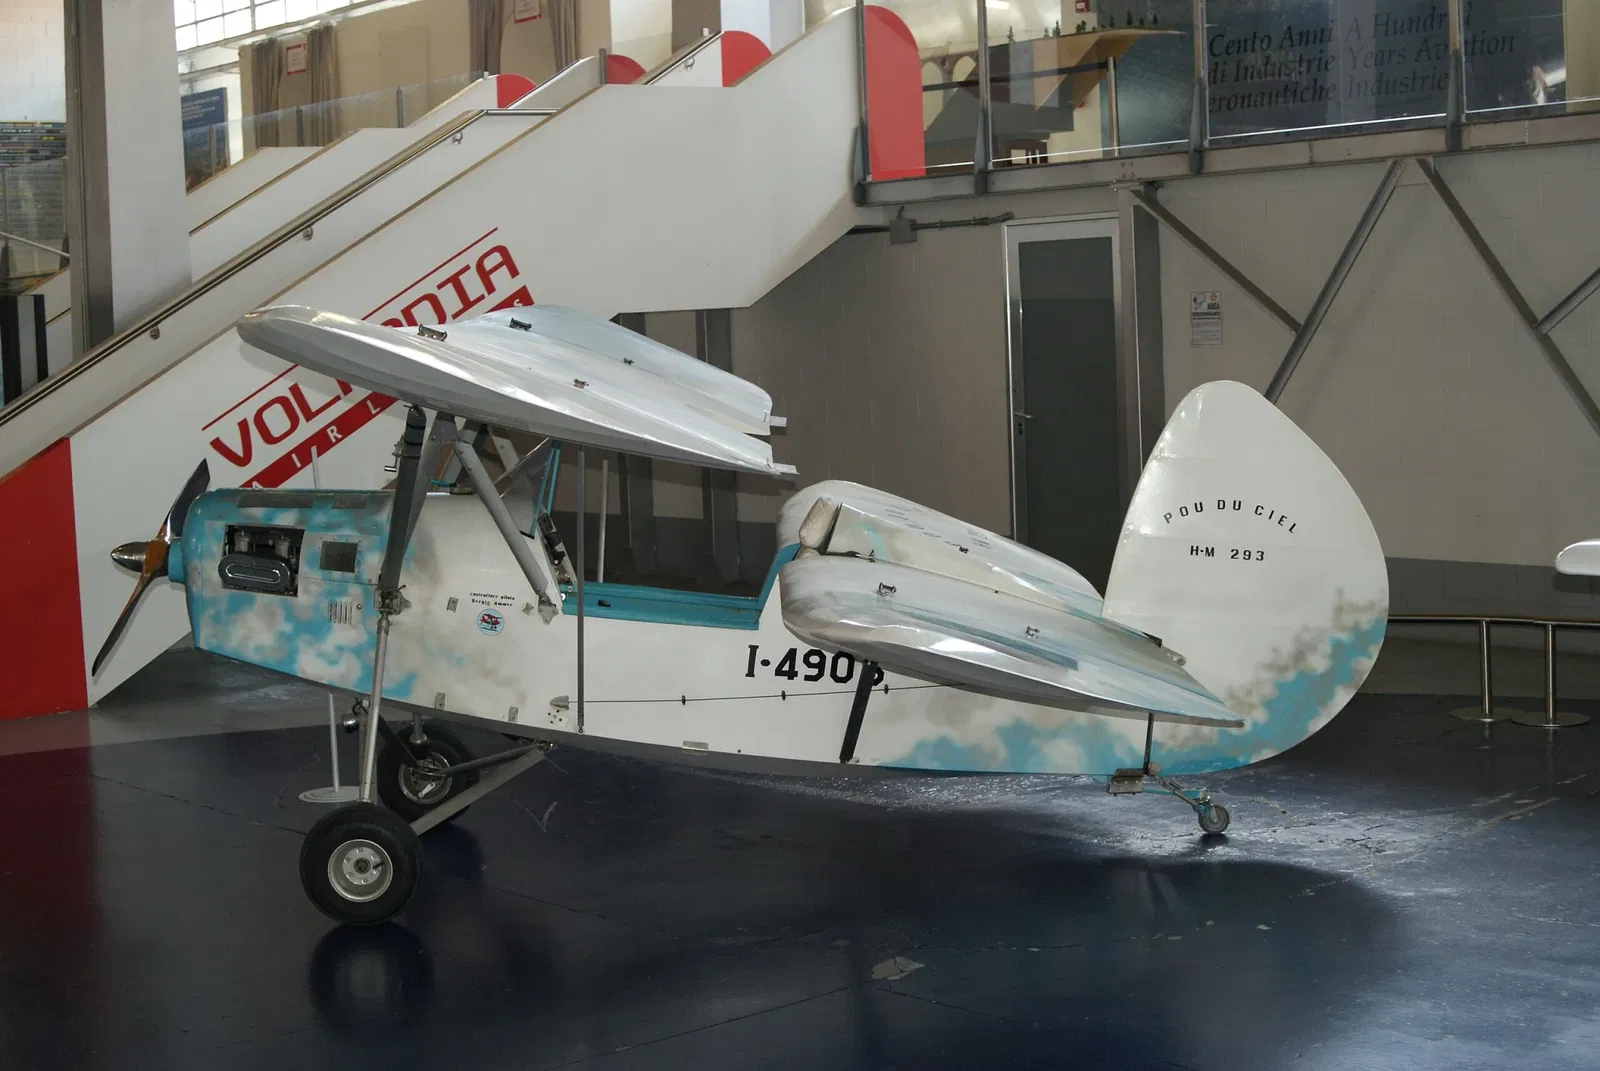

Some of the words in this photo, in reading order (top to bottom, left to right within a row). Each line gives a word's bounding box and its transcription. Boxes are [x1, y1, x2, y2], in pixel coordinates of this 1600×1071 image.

[1209, 31, 1272, 57] Cento
[1279, 20, 1335, 49] Anni
[1344, 17, 1361, 41] A
[1372, 1, 1473, 40] Hundrd
[1233, 49, 1337, 82] Industrie
[1349, 45, 1407, 70] Years
[1414, 30, 1516, 63] Avtion
[1209, 78, 1338, 113] eronautiche
[209, 244, 520, 468] VOLDIA
[1163, 501, 1204, 524] POU
[1217, 499, 1242, 511] DU
[1254, 504, 1297, 534] CIEL
[1230, 548, 1265, 561] 293
